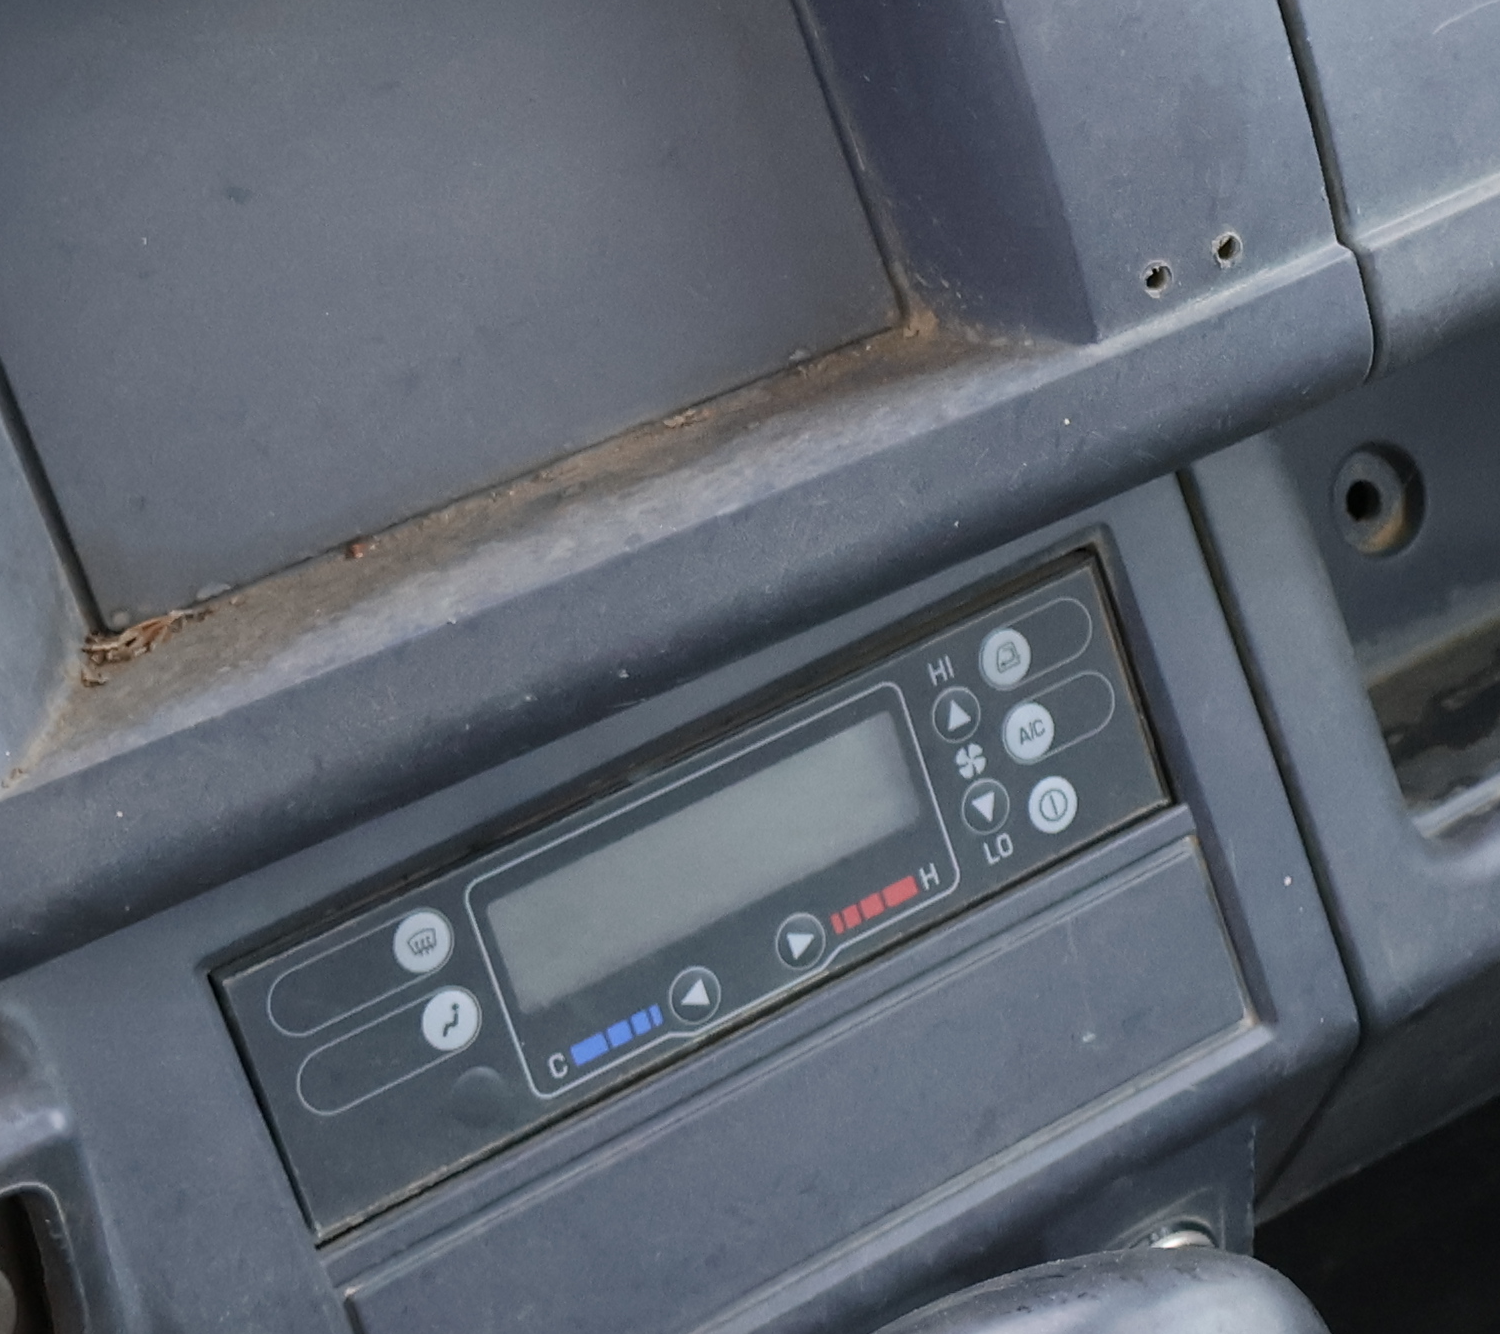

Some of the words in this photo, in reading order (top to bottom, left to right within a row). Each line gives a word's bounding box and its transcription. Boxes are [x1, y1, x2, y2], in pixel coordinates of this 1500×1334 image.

[927, 654, 955, 687] HI
[1018, 718, 1047, 746] A/C
[982, 832, 1015, 865] LO
[918, 861, 942, 891] H
[547, 1052, 571, 1082] C
